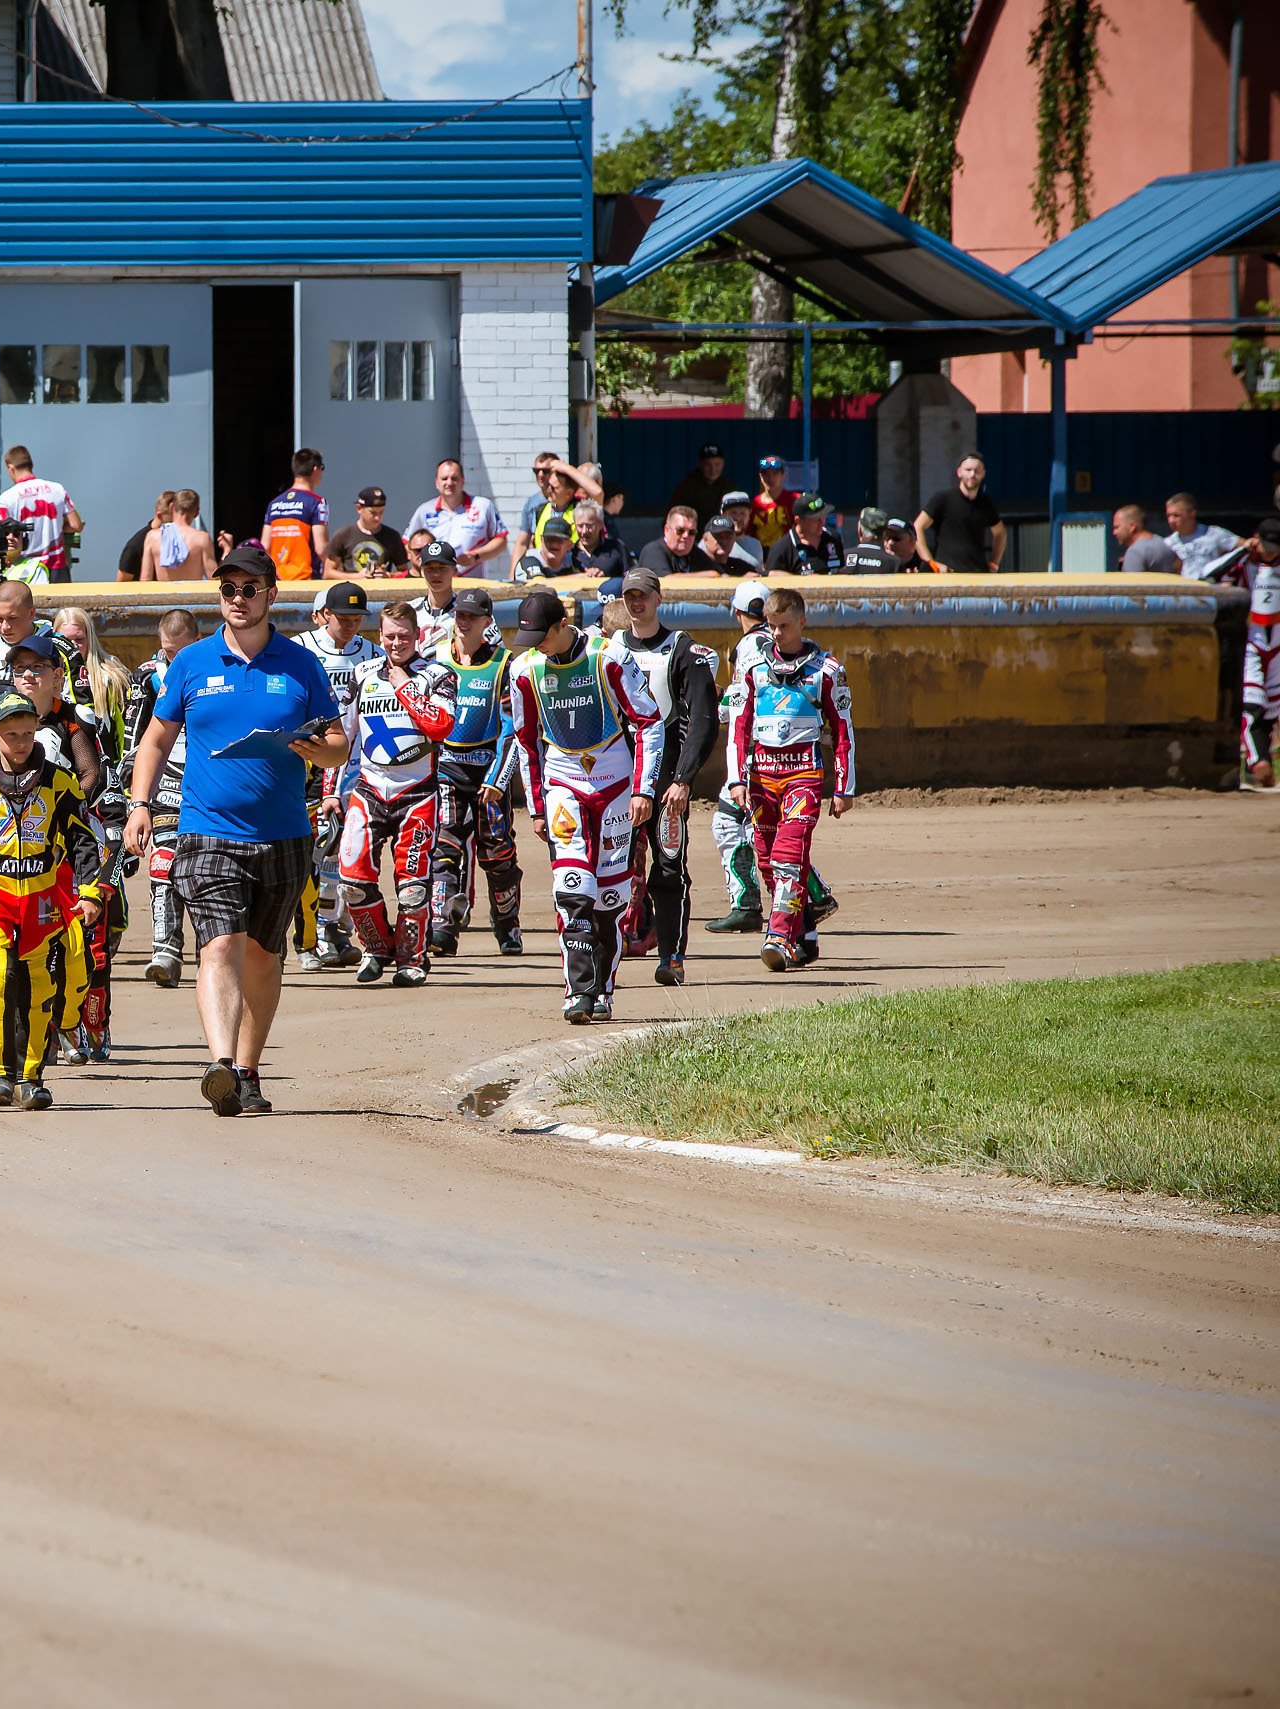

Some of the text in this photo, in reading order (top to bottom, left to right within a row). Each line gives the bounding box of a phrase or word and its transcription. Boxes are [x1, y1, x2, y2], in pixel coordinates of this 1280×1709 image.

[457, 695, 487, 707] UNĪBA
[548, 694, 594, 710] JAUNĪBA
[458, 707, 468, 725] 1
[568, 711, 576, 729] 1
